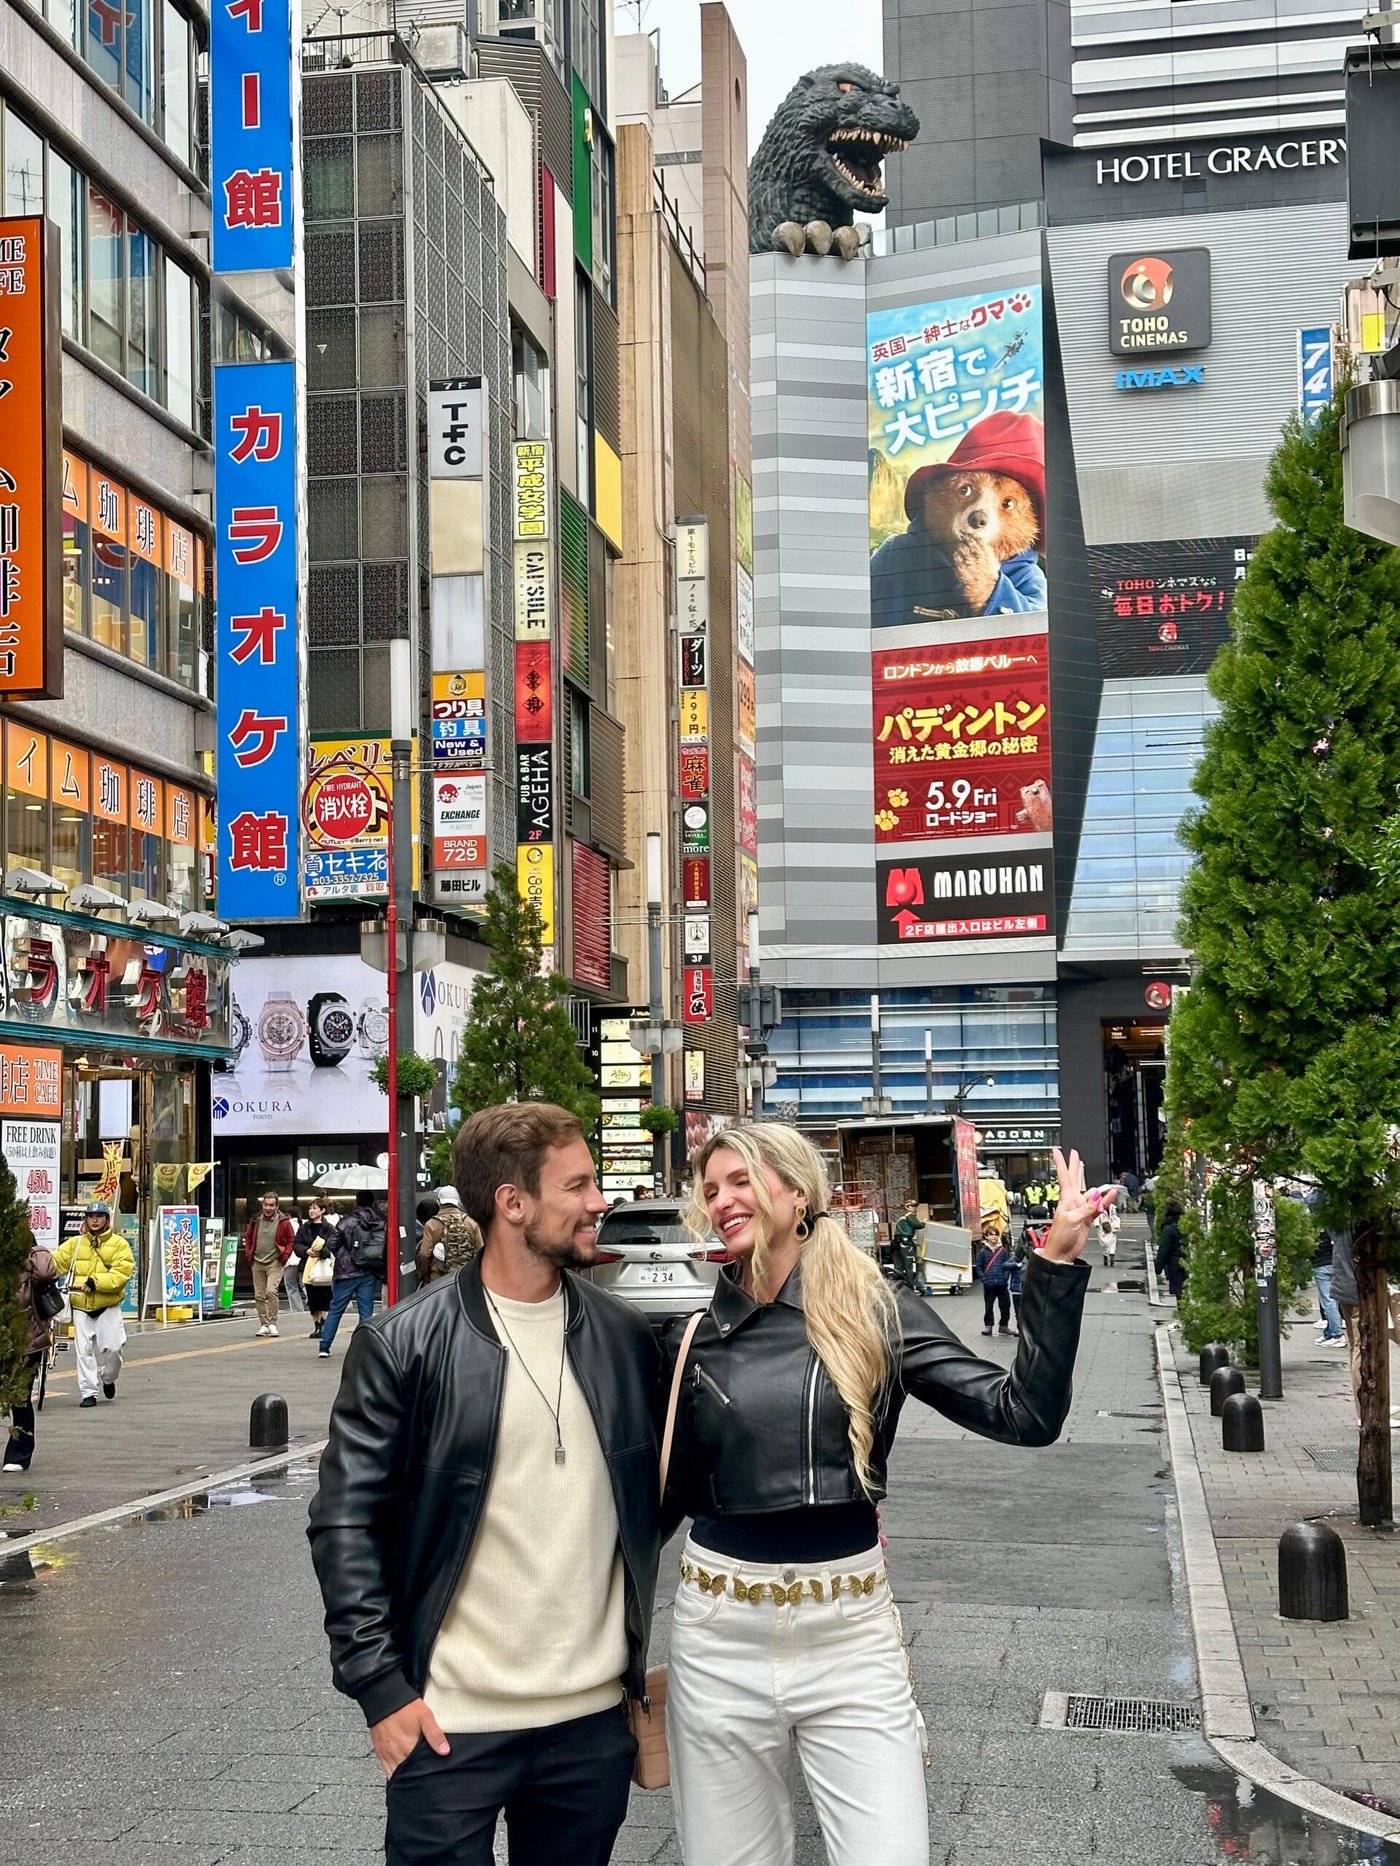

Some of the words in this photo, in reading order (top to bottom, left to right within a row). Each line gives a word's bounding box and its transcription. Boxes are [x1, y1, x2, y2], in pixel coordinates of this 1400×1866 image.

[1096, 152, 1201, 185] HOTEL
[873, 300, 1005, 361] 英国一紳士なクマ
[1120, 316, 1168, 334] TOHO
[1120, 330, 1188, 348] CINEMAS
[875, 347, 987, 408] 新宿で
[1116, 364, 1205, 390] IMAX
[885, 368, 1041, 454] 大ピンチ
[526, 552, 545, 629] CAPSULE
[1114, 591, 1225, 617] 毎日おトク!
[228, 405, 289, 872] カラオケ館
[690, 638, 703, 675] ダーツ
[884, 654, 1038, 680] ロンドンから故郷ペルーへ
[434, 699, 484, 718] つり具
[689, 692, 699, 734] 299円
[876, 700, 1046, 742] パディントン
[435, 740, 466, 749] New
[470, 739, 479, 747] &
[448, 747, 483, 757] Used
[889, 735, 1038, 765] 消えた黄金郷の秘密
[520, 754, 530, 773] BAR
[683, 756, 706, 792] 麻雀
[16, 737, 190, 840] イム珈琲店
[323, 784, 335, 793] FIRE
[336, 781, 362, 791] HYDRANT
[520, 784, 531, 803] PUB
[531, 750, 550, 829] AGEHA
[925, 779, 971, 810] 5.9
[973, 788, 997, 807] Fri
[319, 792, 368, 822] 消火栓
[440, 810, 480, 820] EXCHANGE
[926, 810, 997, 827] ロードショー
[443, 840, 478, 848] BRAND
[529, 830, 543, 840] 2F
[443, 848, 478, 862] 729
[683, 845, 710, 853] more
[325, 851, 387, 874] セキネ
[323, 885, 359, 895] アルタ裏
[366, 883, 384, 892] 買取
[933, 864, 1044, 899] MARUHAN
[905, 918, 1038, 936] 2F店舗出入口はビル左側
[438, 981, 470, 1010] OKUR
[34, 1060, 58, 1081] TIME
[34, 1083, 58, 1104] CAFE
[233, 1101, 292, 1113] OKURA
[6, 1126, 27, 1143] FREE
[30, 1127, 56, 1144] DRINK
[985, 1130, 1044, 1138] ACORN
[316, 1163, 360, 1174] OKU
[29, 1206, 52, 1230] 50円
[170, 1232, 182, 1285] できます
[180, 1217, 194, 1297] すぐにご案内
